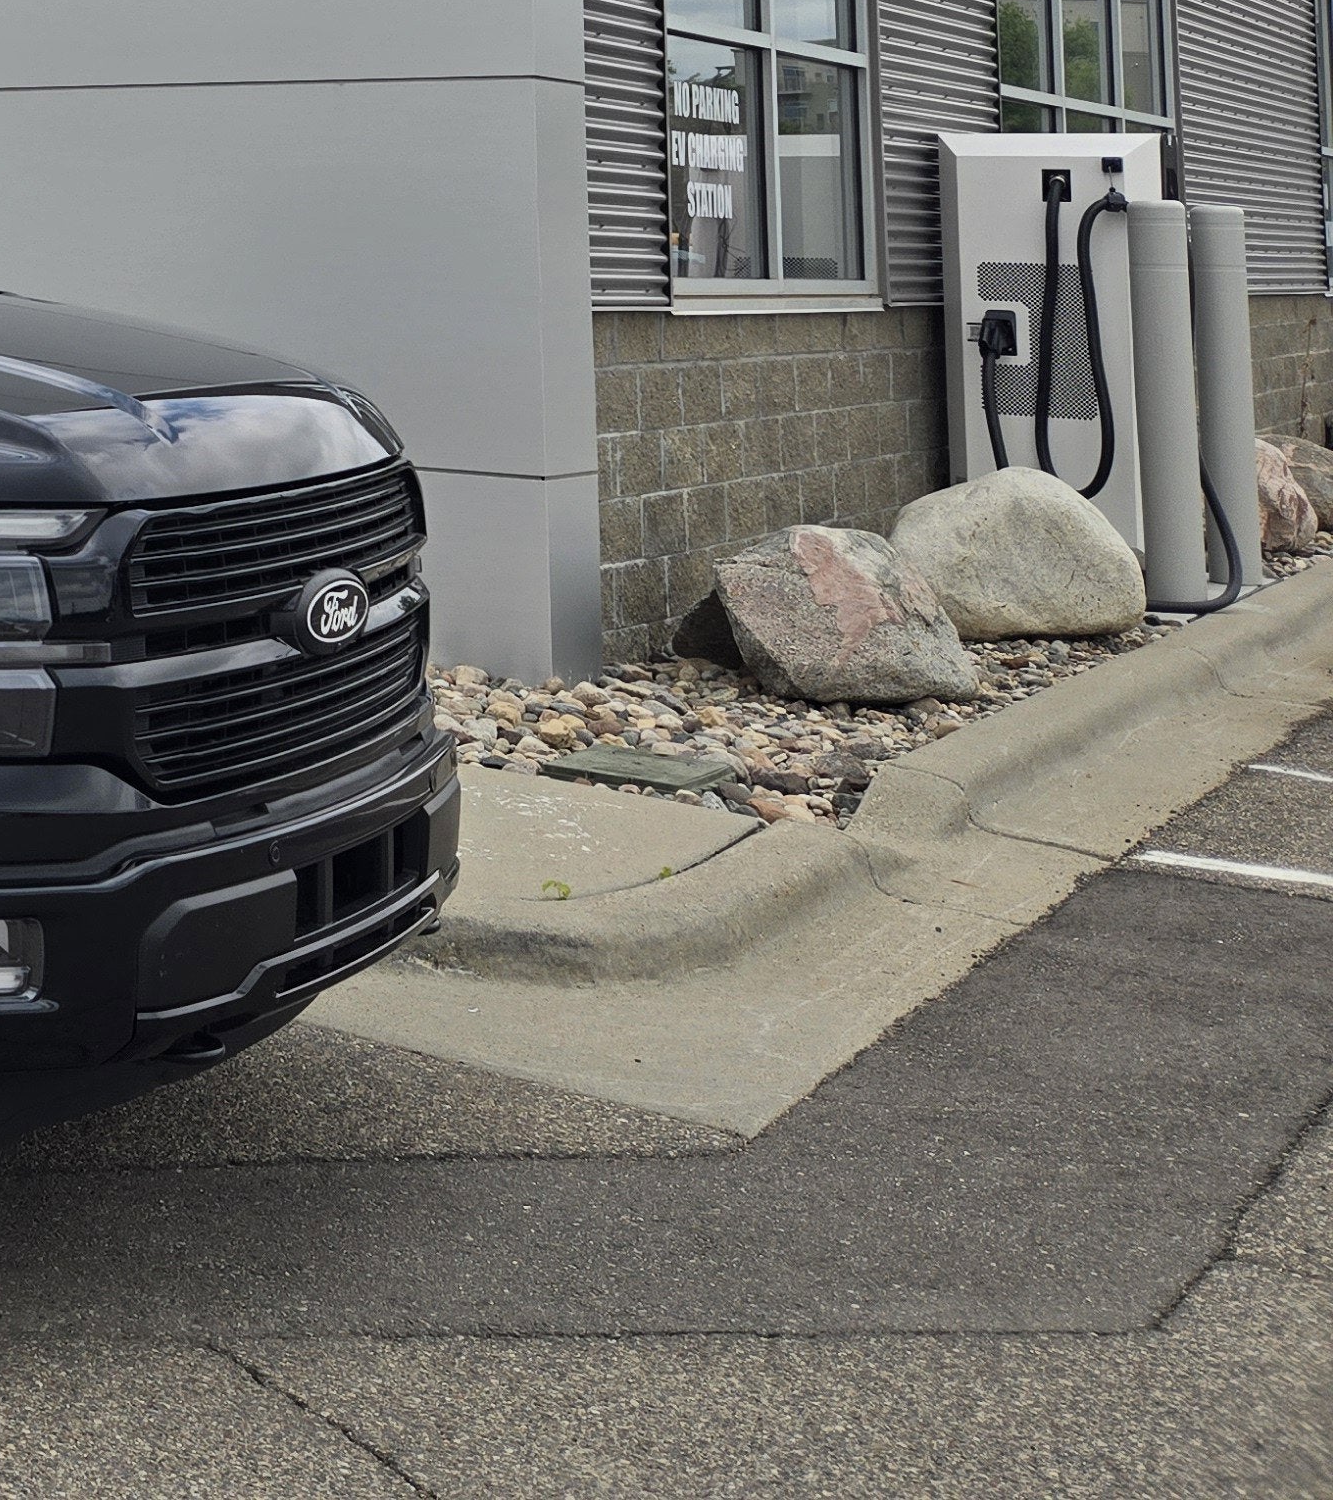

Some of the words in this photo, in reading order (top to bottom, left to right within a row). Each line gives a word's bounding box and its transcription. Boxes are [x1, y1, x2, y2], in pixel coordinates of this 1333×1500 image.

[674, 81, 690, 118] NO
[692, 84, 740, 124] PARKING
[671, 130, 686, 166] EV
[688, 131, 744, 172] CHARGING
[687, 181, 733, 219] STATION
[320, 589, 359, 635] Ford
